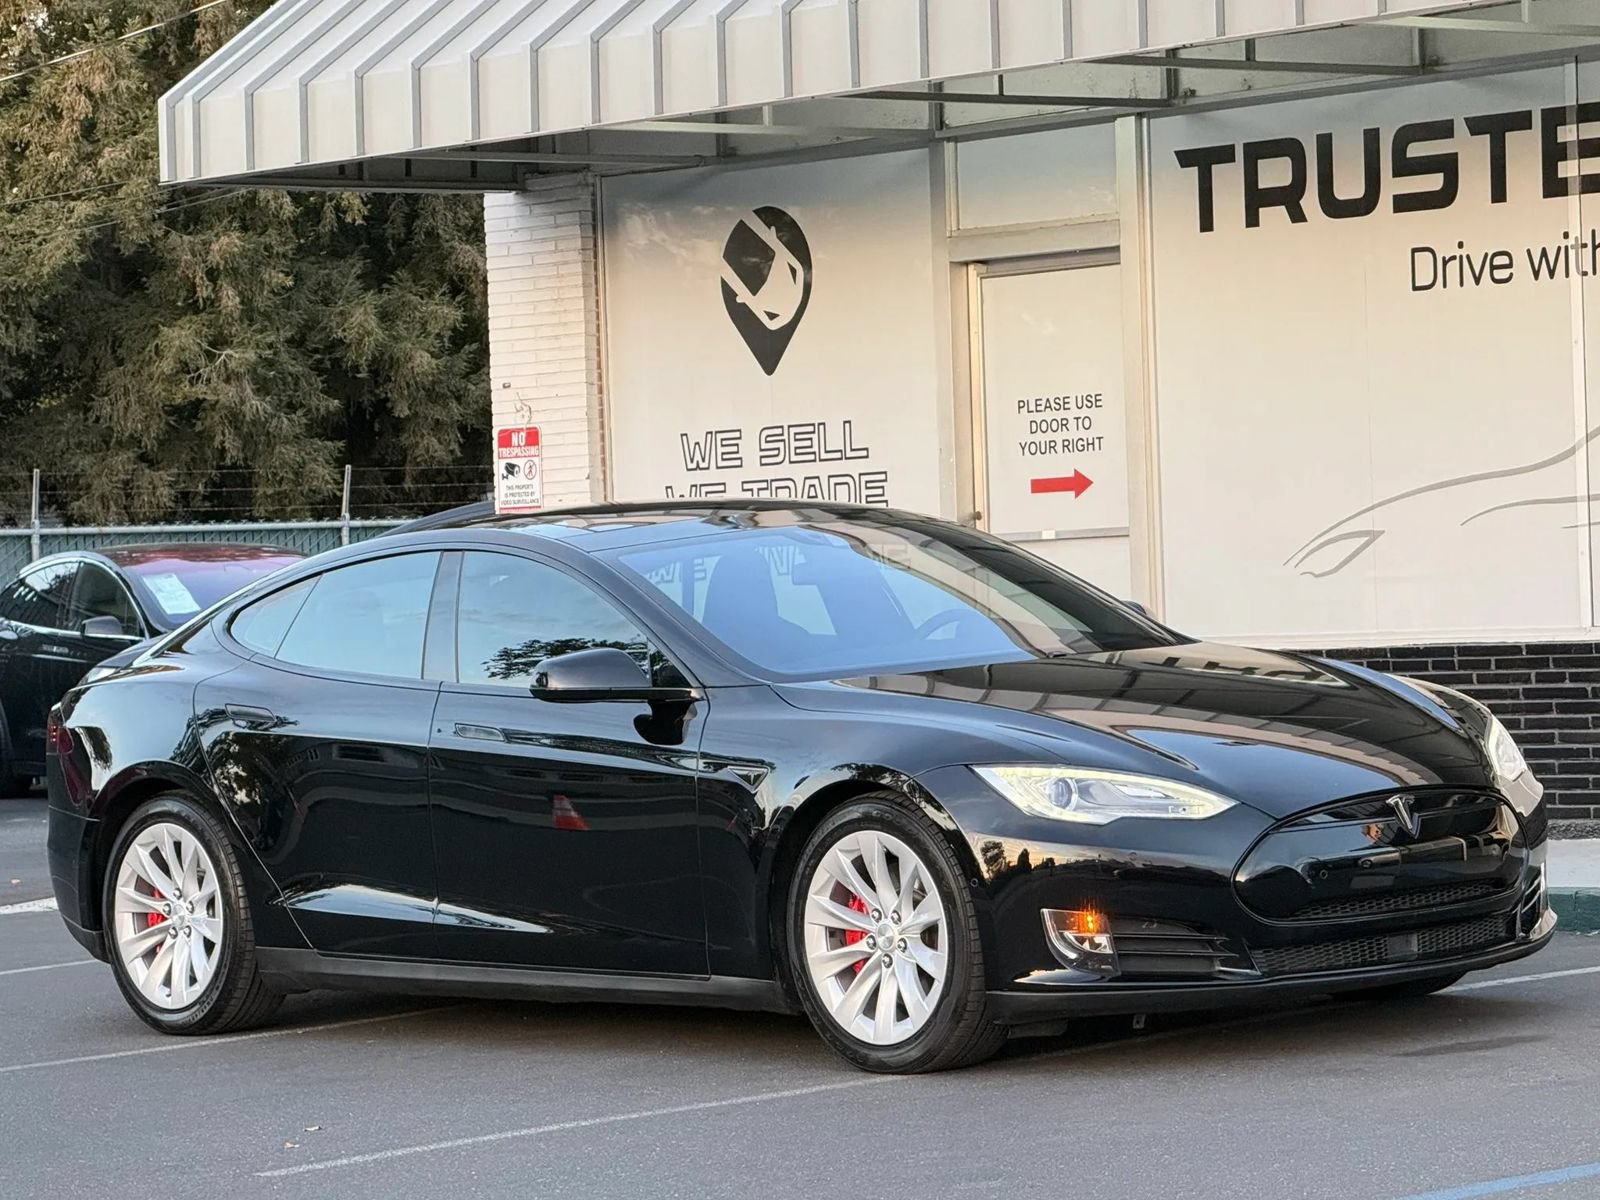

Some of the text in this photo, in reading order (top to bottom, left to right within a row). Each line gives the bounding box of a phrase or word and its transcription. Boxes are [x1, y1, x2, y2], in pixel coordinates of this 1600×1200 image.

[1174, 101, 1600, 233] TRUSTE
[1410, 240, 1514, 292] Drive
[1017, 393, 1103, 415] PLEASE USE
[1029, 415, 1092, 435] DOOR TO
[511, 431, 526, 448] NO
[680, 420, 870, 472] WE SELL
[1019, 436, 1104, 457] YOUR RIGHT
[499, 447, 540, 458] TRESPASSING
